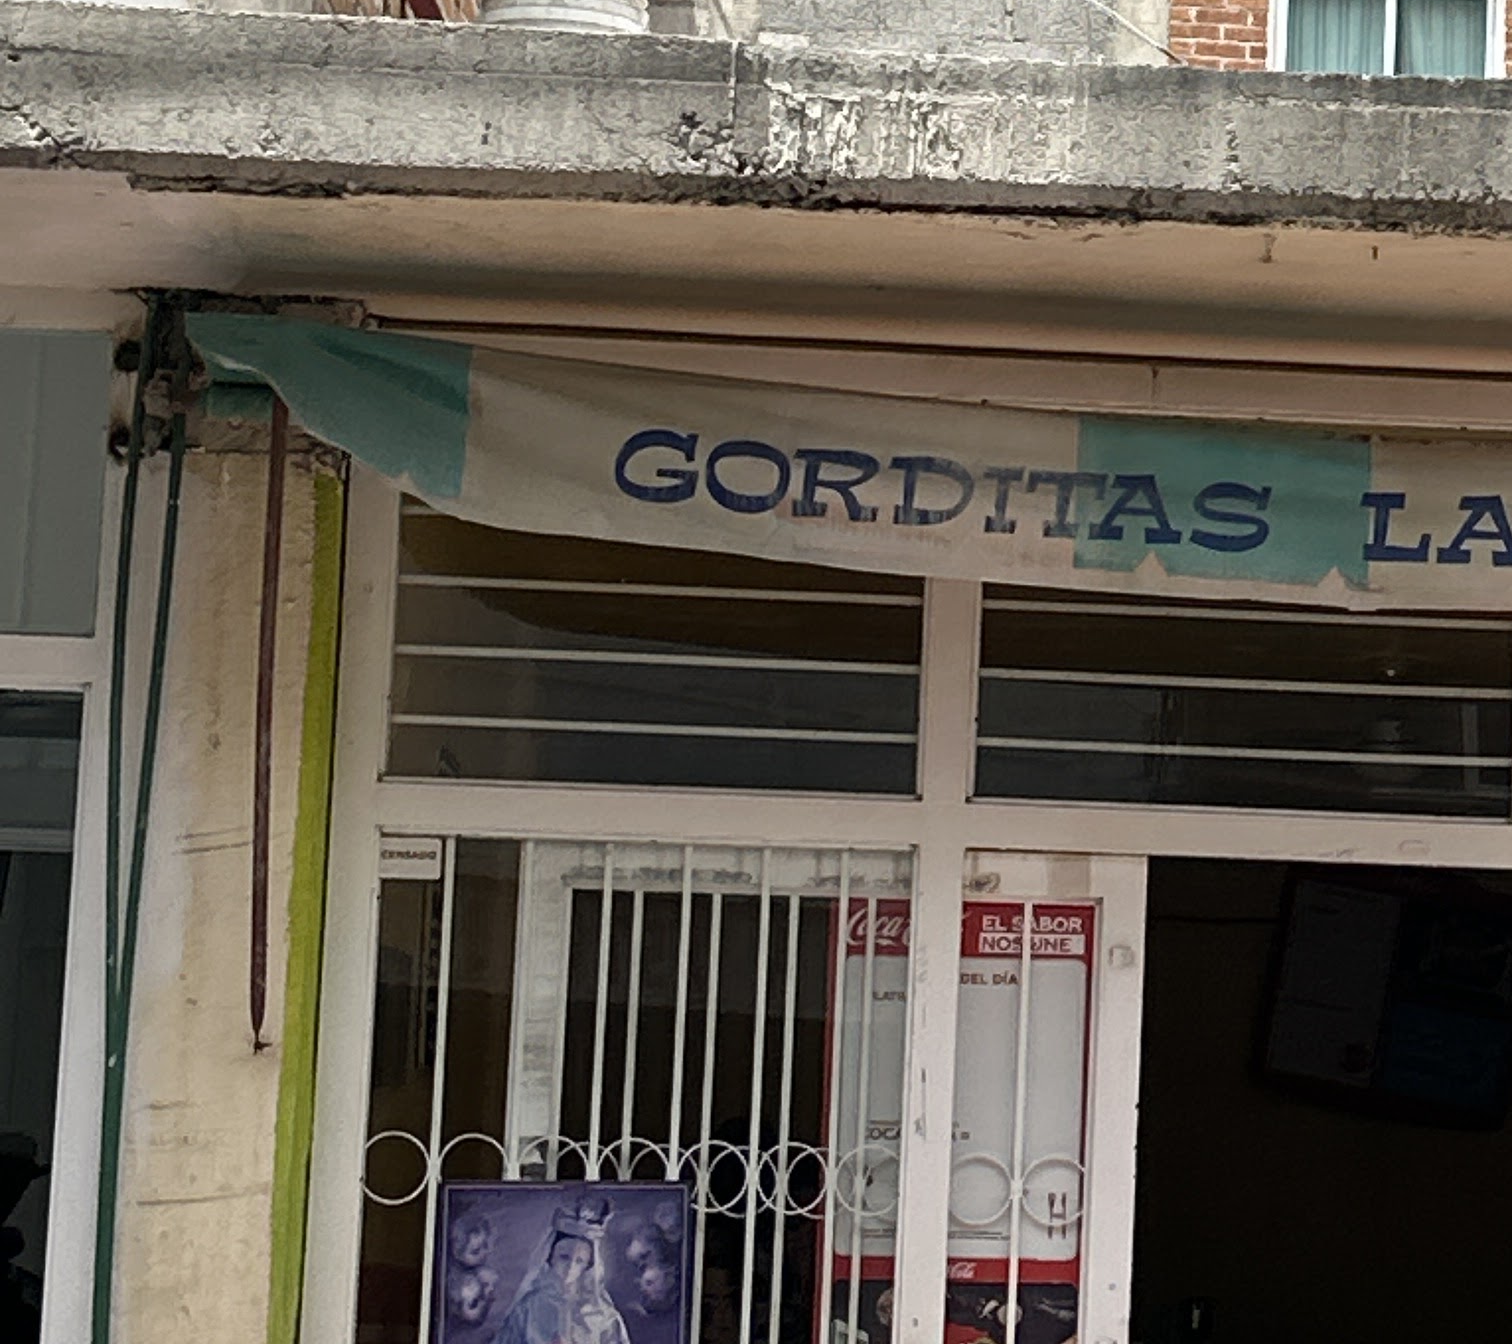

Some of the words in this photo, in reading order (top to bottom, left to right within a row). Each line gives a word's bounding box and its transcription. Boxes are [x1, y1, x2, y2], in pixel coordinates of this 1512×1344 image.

[614, 428, 1272, 553] GORDITAS
[982, 914, 1007, 932] EL
[982, 936, 1023, 951] NOS
